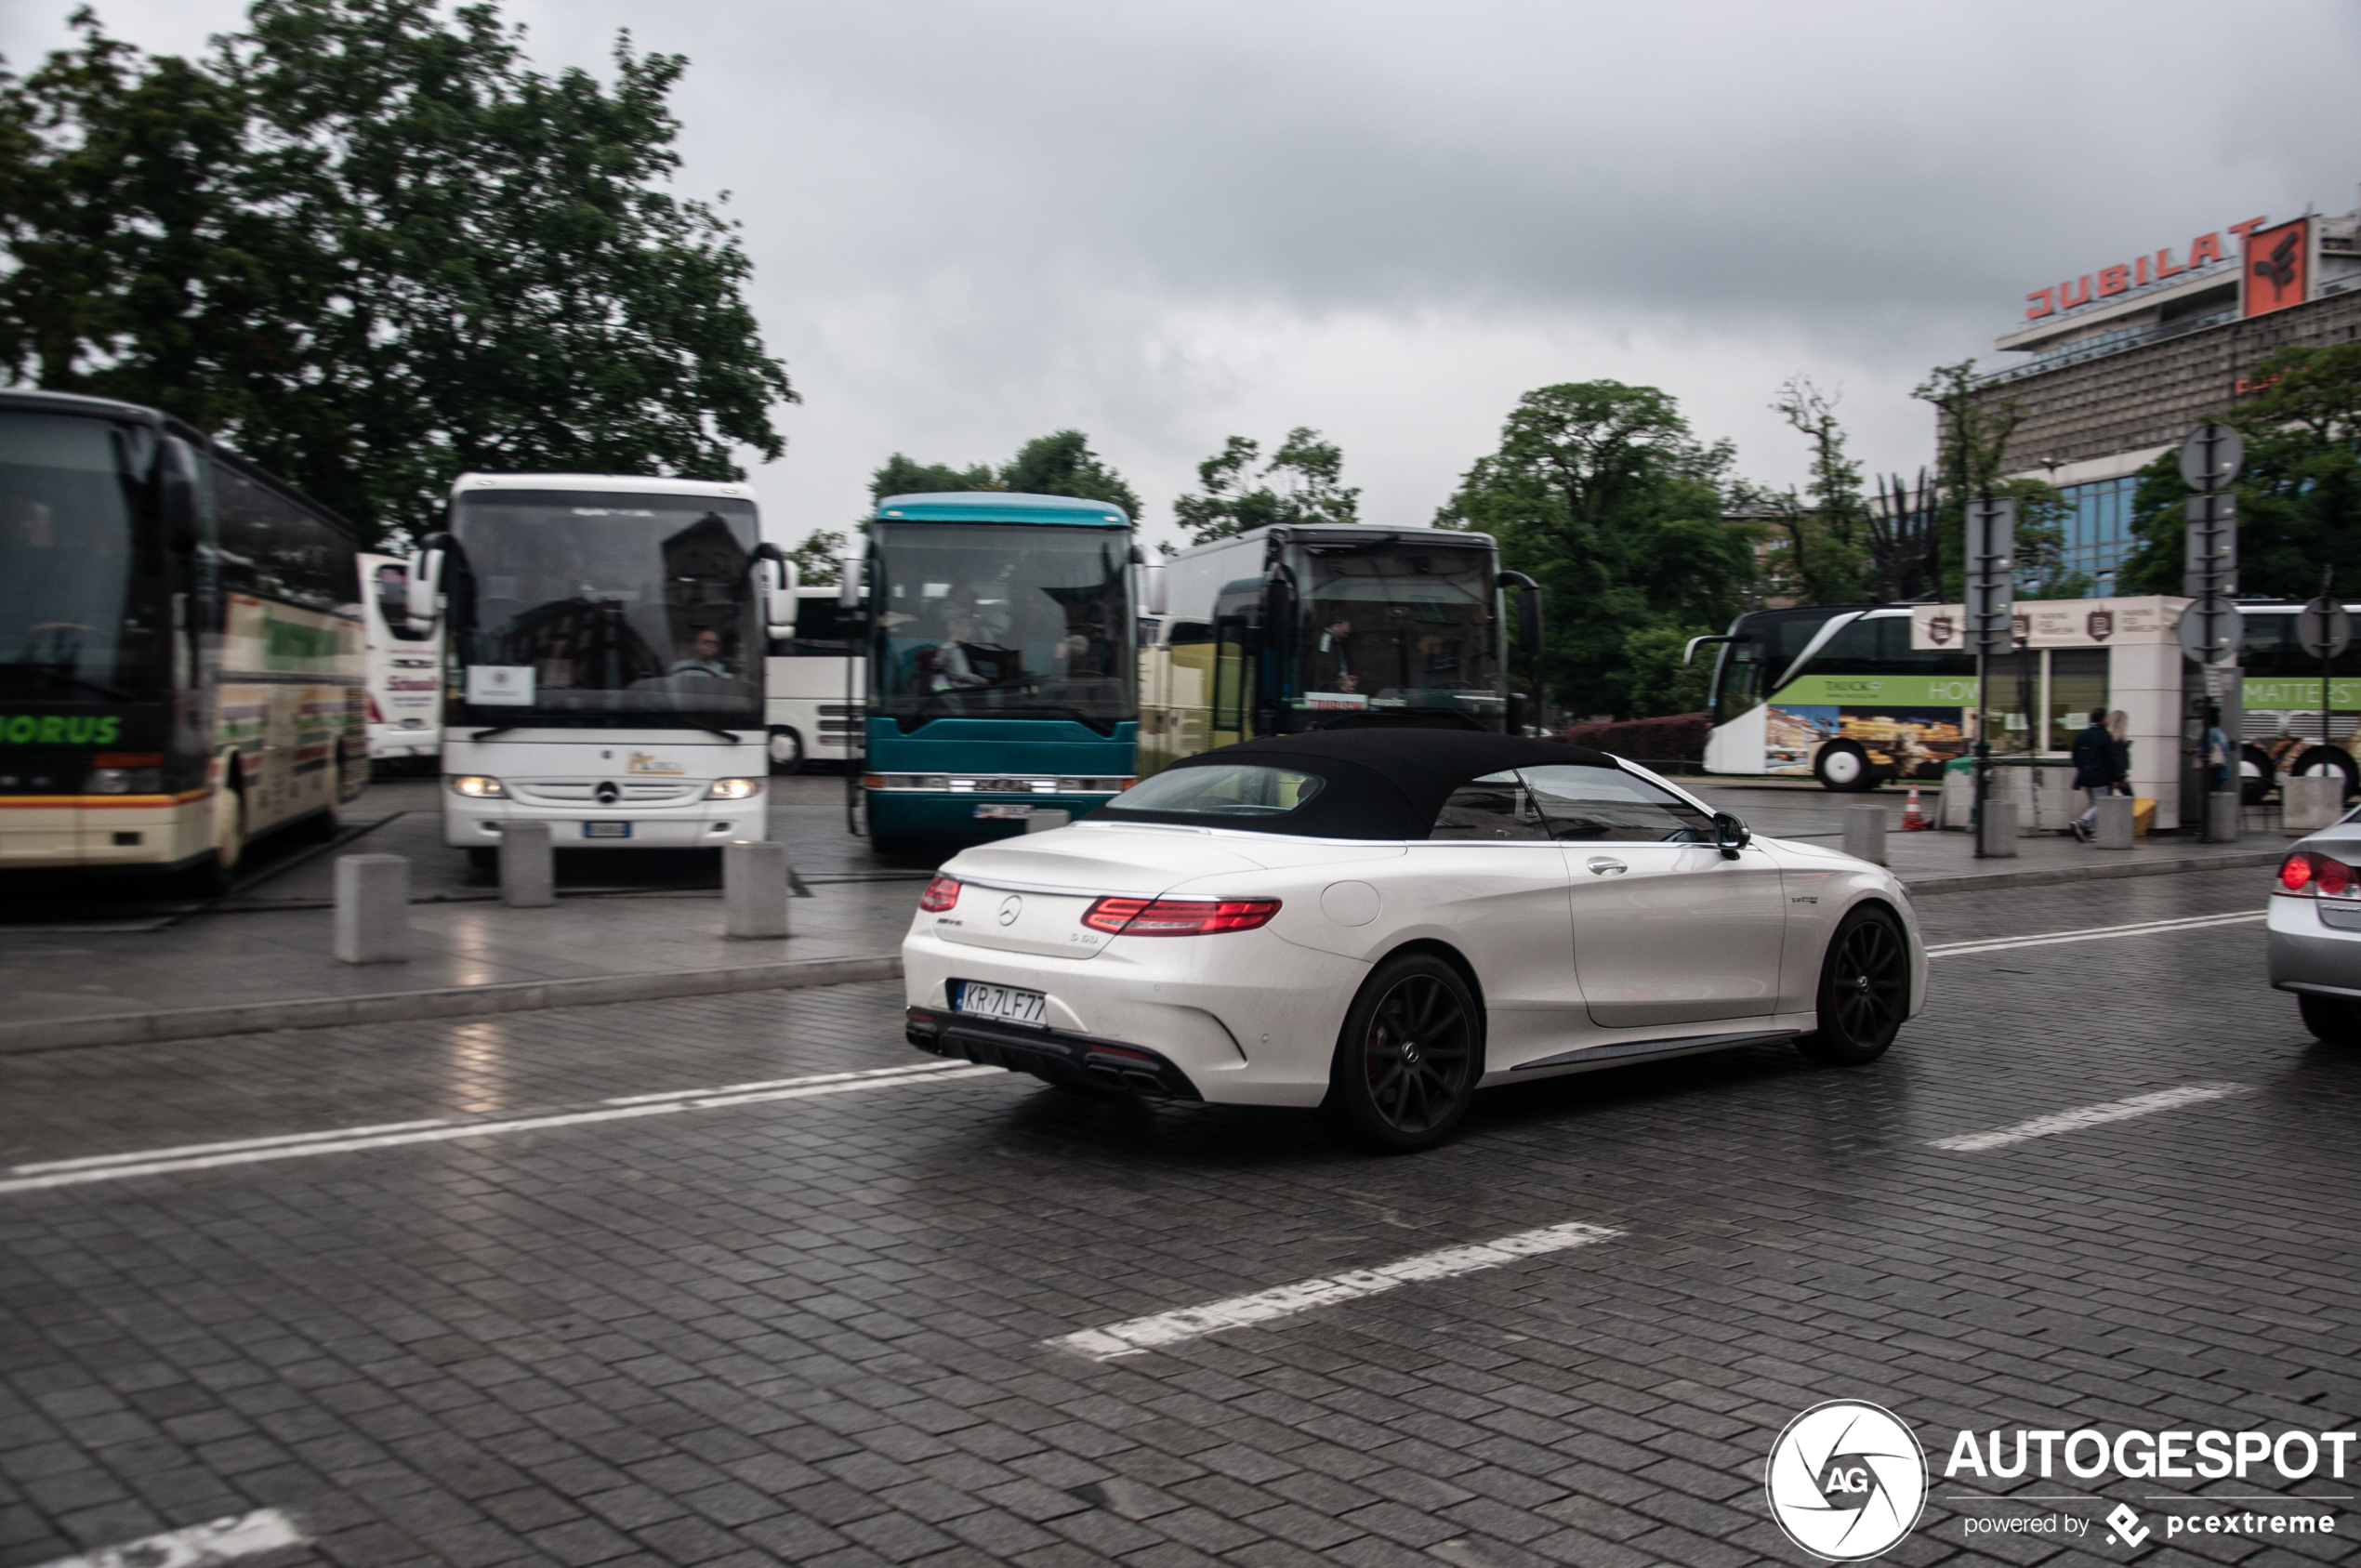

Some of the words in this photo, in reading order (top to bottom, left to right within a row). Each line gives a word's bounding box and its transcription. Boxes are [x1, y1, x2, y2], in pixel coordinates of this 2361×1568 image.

[2025, 216, 2267, 320] JUBILAT
[967, 984, 988, 1011] KR
[992, 989, 1046, 1021] 7LF77
